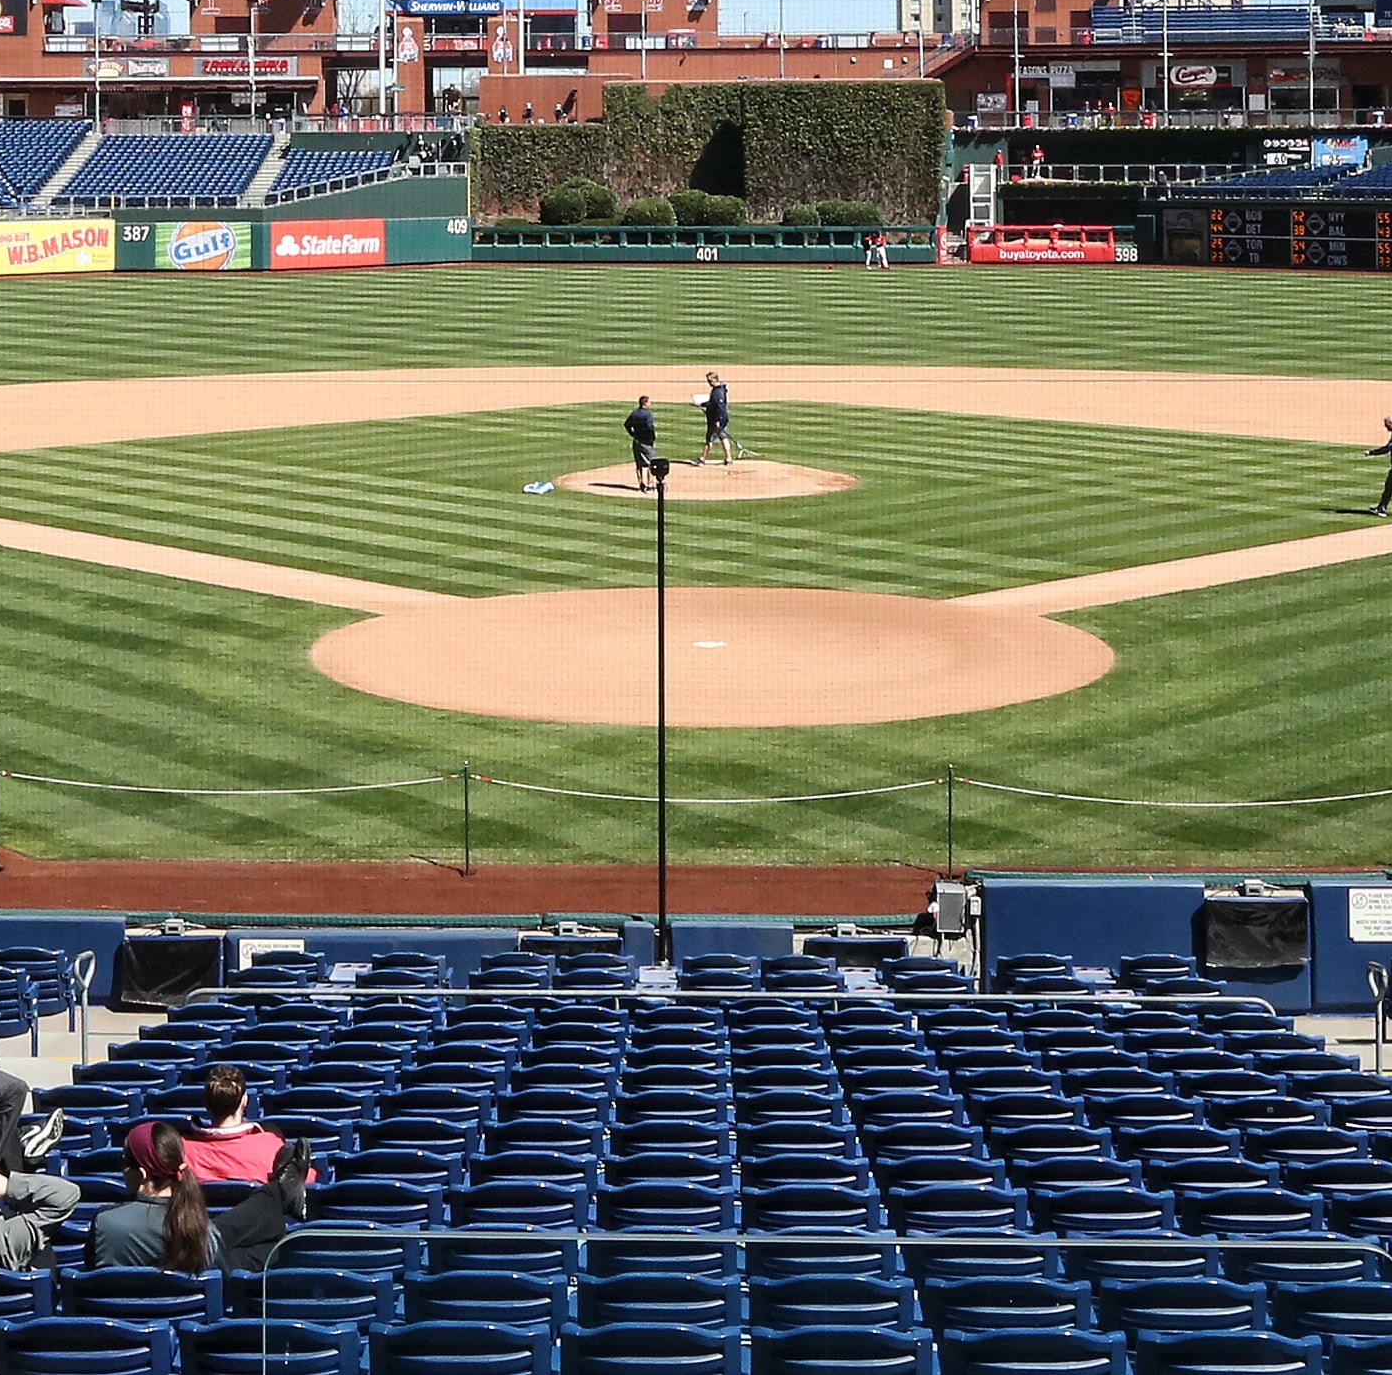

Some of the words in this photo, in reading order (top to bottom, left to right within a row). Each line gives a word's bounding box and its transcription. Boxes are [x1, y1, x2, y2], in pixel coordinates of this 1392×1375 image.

[122, 225, 150, 243] 387
[446, 218, 468, 235] 409
[1245, 224, 1261, 234] DET
[1328, 226, 1346, 236] BAL
[173, 230, 229, 261] Gulf
[300, 234, 380, 256] StateFarm
[695, 246, 719, 263] 401
[998, 248, 1085, 263] buyatoyota.com
[1114, 247, 1139, 263] 398
